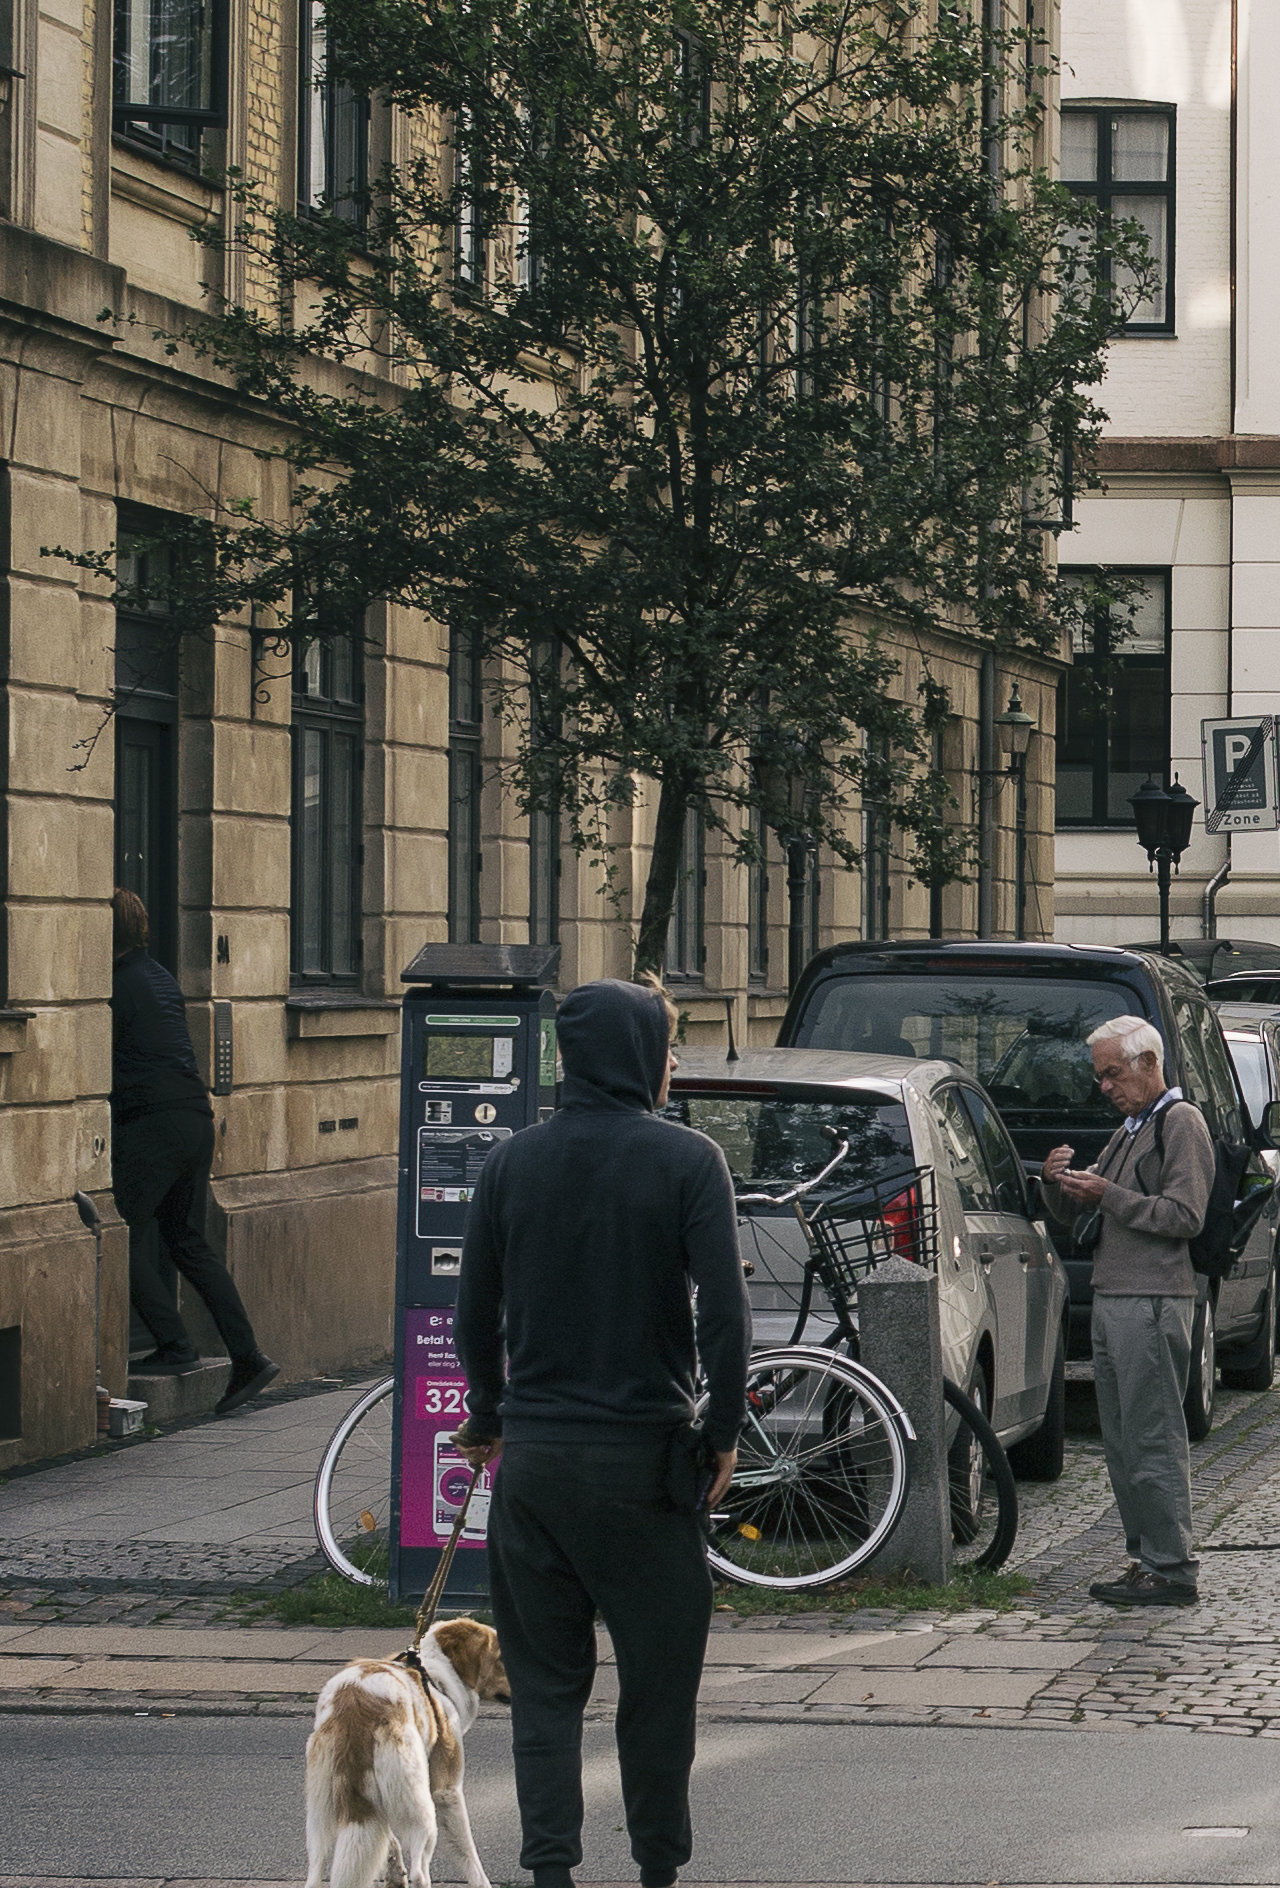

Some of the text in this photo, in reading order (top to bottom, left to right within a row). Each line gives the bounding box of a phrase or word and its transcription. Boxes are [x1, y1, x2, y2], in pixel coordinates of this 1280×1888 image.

[1225, 734, 1252, 773] P
[1223, 814, 1261, 826] Zone
[416, 1335, 444, 1345] Betal
